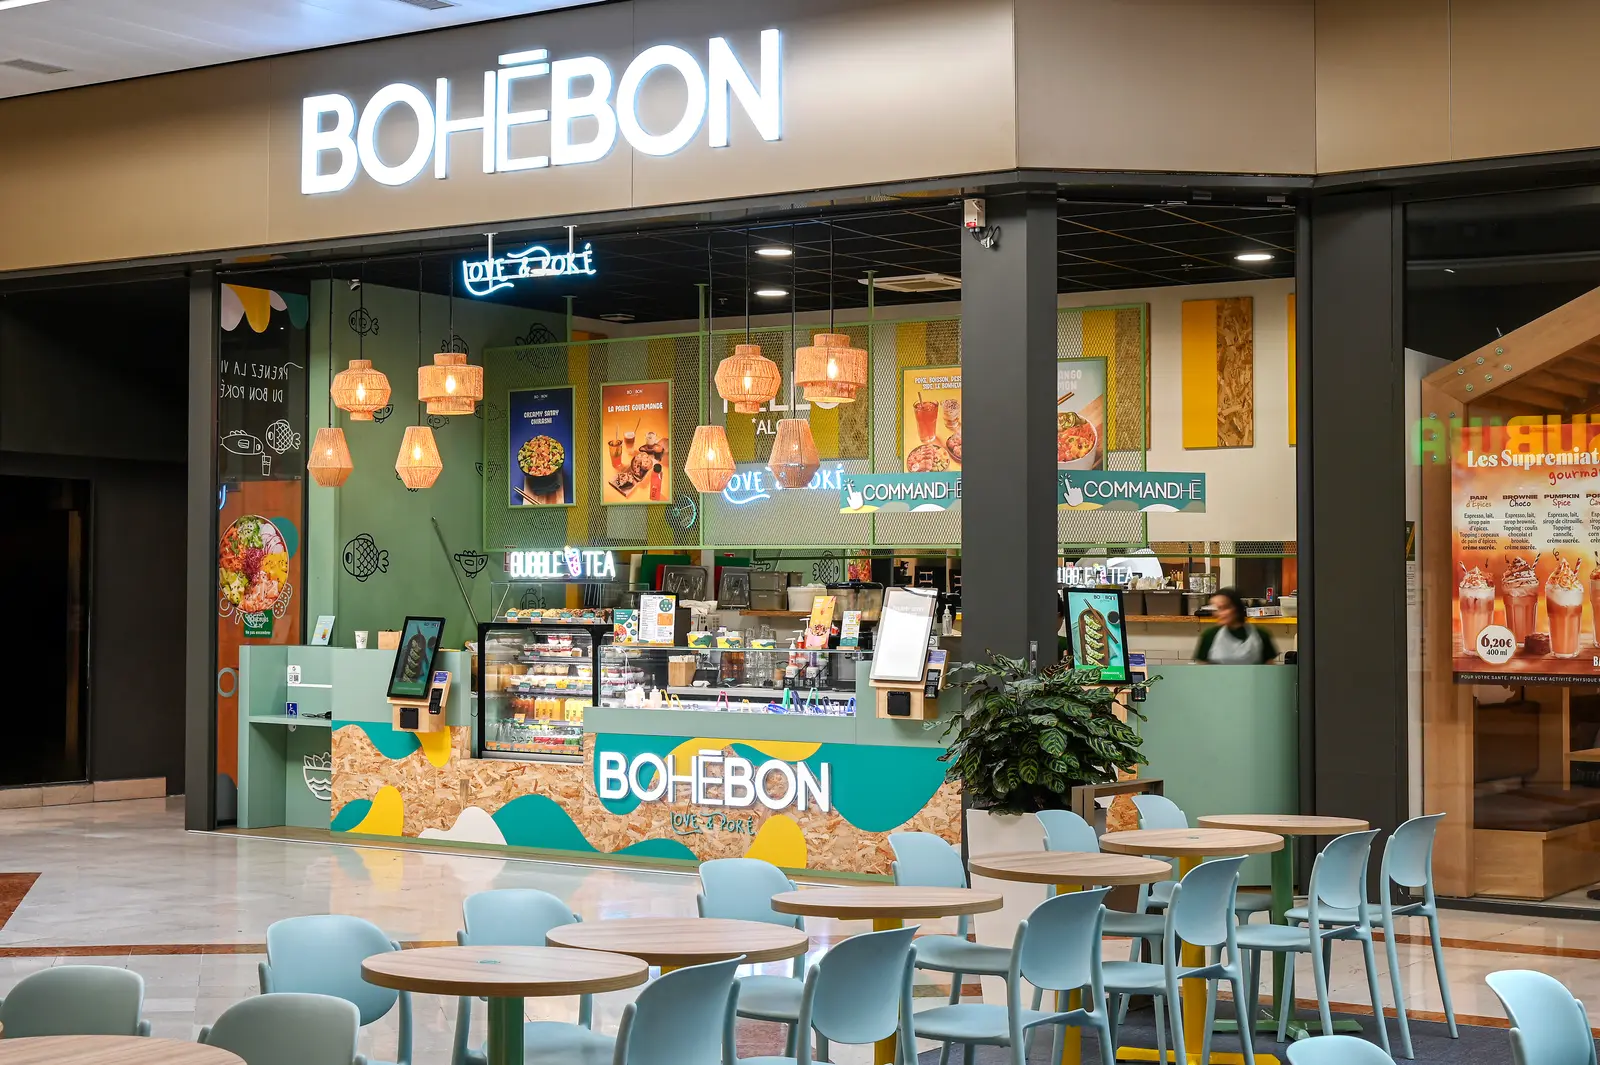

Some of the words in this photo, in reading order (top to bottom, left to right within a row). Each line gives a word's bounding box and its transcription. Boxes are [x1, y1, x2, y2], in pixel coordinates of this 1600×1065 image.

[462, 258, 514, 296] LOVE
[523, 410, 544, 419] CREAMY
[607, 405, 615, 413] LA
[615, 404, 631, 412] PAUSE
[631, 402, 663, 411] GOURMANDE
[1467, 450, 1498, 468] Les
[1548, 467, 1600, 486] gourma
[1509, 499, 1532, 508] Choco
[1552, 498, 1571, 508] Spice
[510, 550, 565, 578] BUBBLE
[582, 550, 616, 578] TEA
[1057, 566, 1093, 585] UBBLE
[1107, 566, 1133, 585] TEA
[1480, 633, 1513, 649] 6,20€
[1486, 648, 1499, 656] 400
[1499, 648, 1508, 656] ml
[669, 811, 704, 836] LOVE
[700, 811, 758, 836] POKÉ
[706, 815, 714, 830] &
